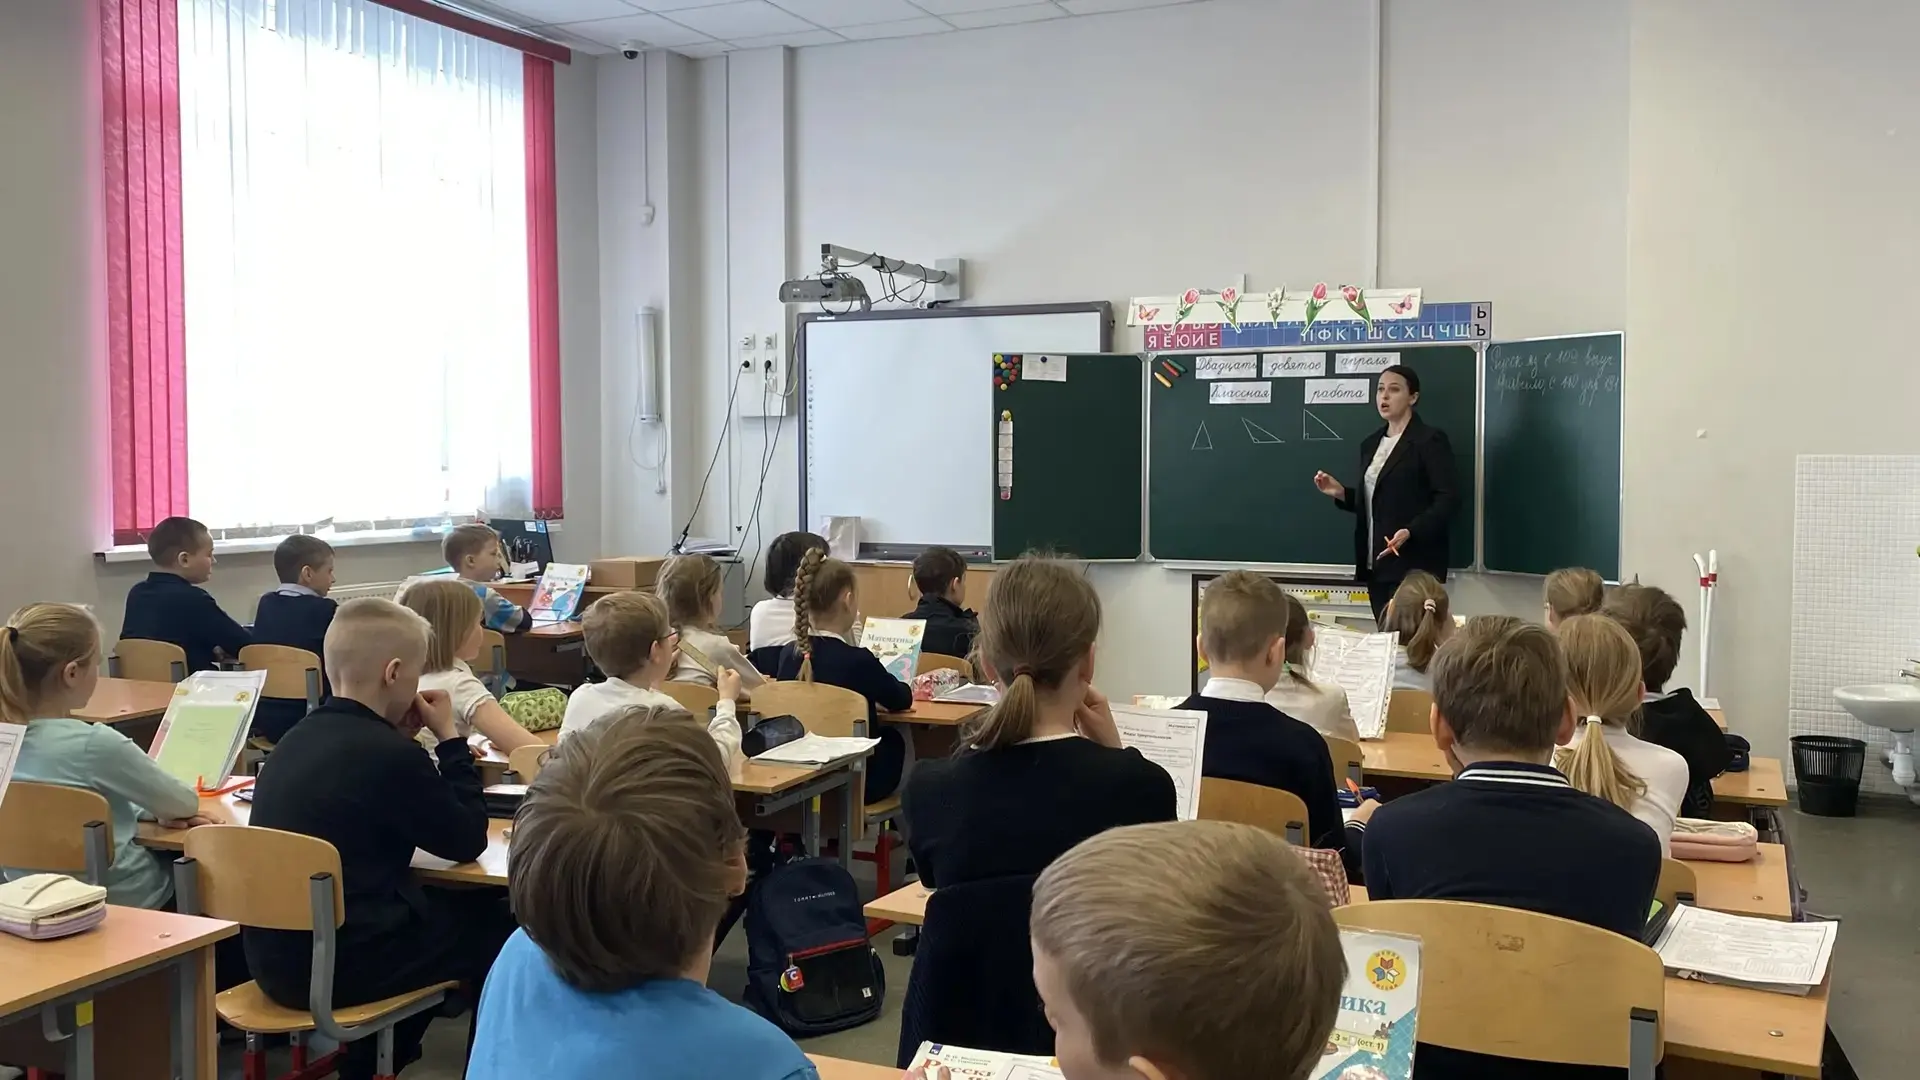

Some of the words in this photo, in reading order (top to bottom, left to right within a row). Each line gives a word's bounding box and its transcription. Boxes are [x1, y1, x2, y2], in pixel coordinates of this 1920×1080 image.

[1196, 357, 1257, 375] Двадцать
[1270, 357, 1321, 376] девятое
[1340, 355, 1389, 371] апреля
[1211, 383, 1269, 398] Классная
[1310, 383, 1364, 403] работа
[1340, 995, 1387, 1016] ика
